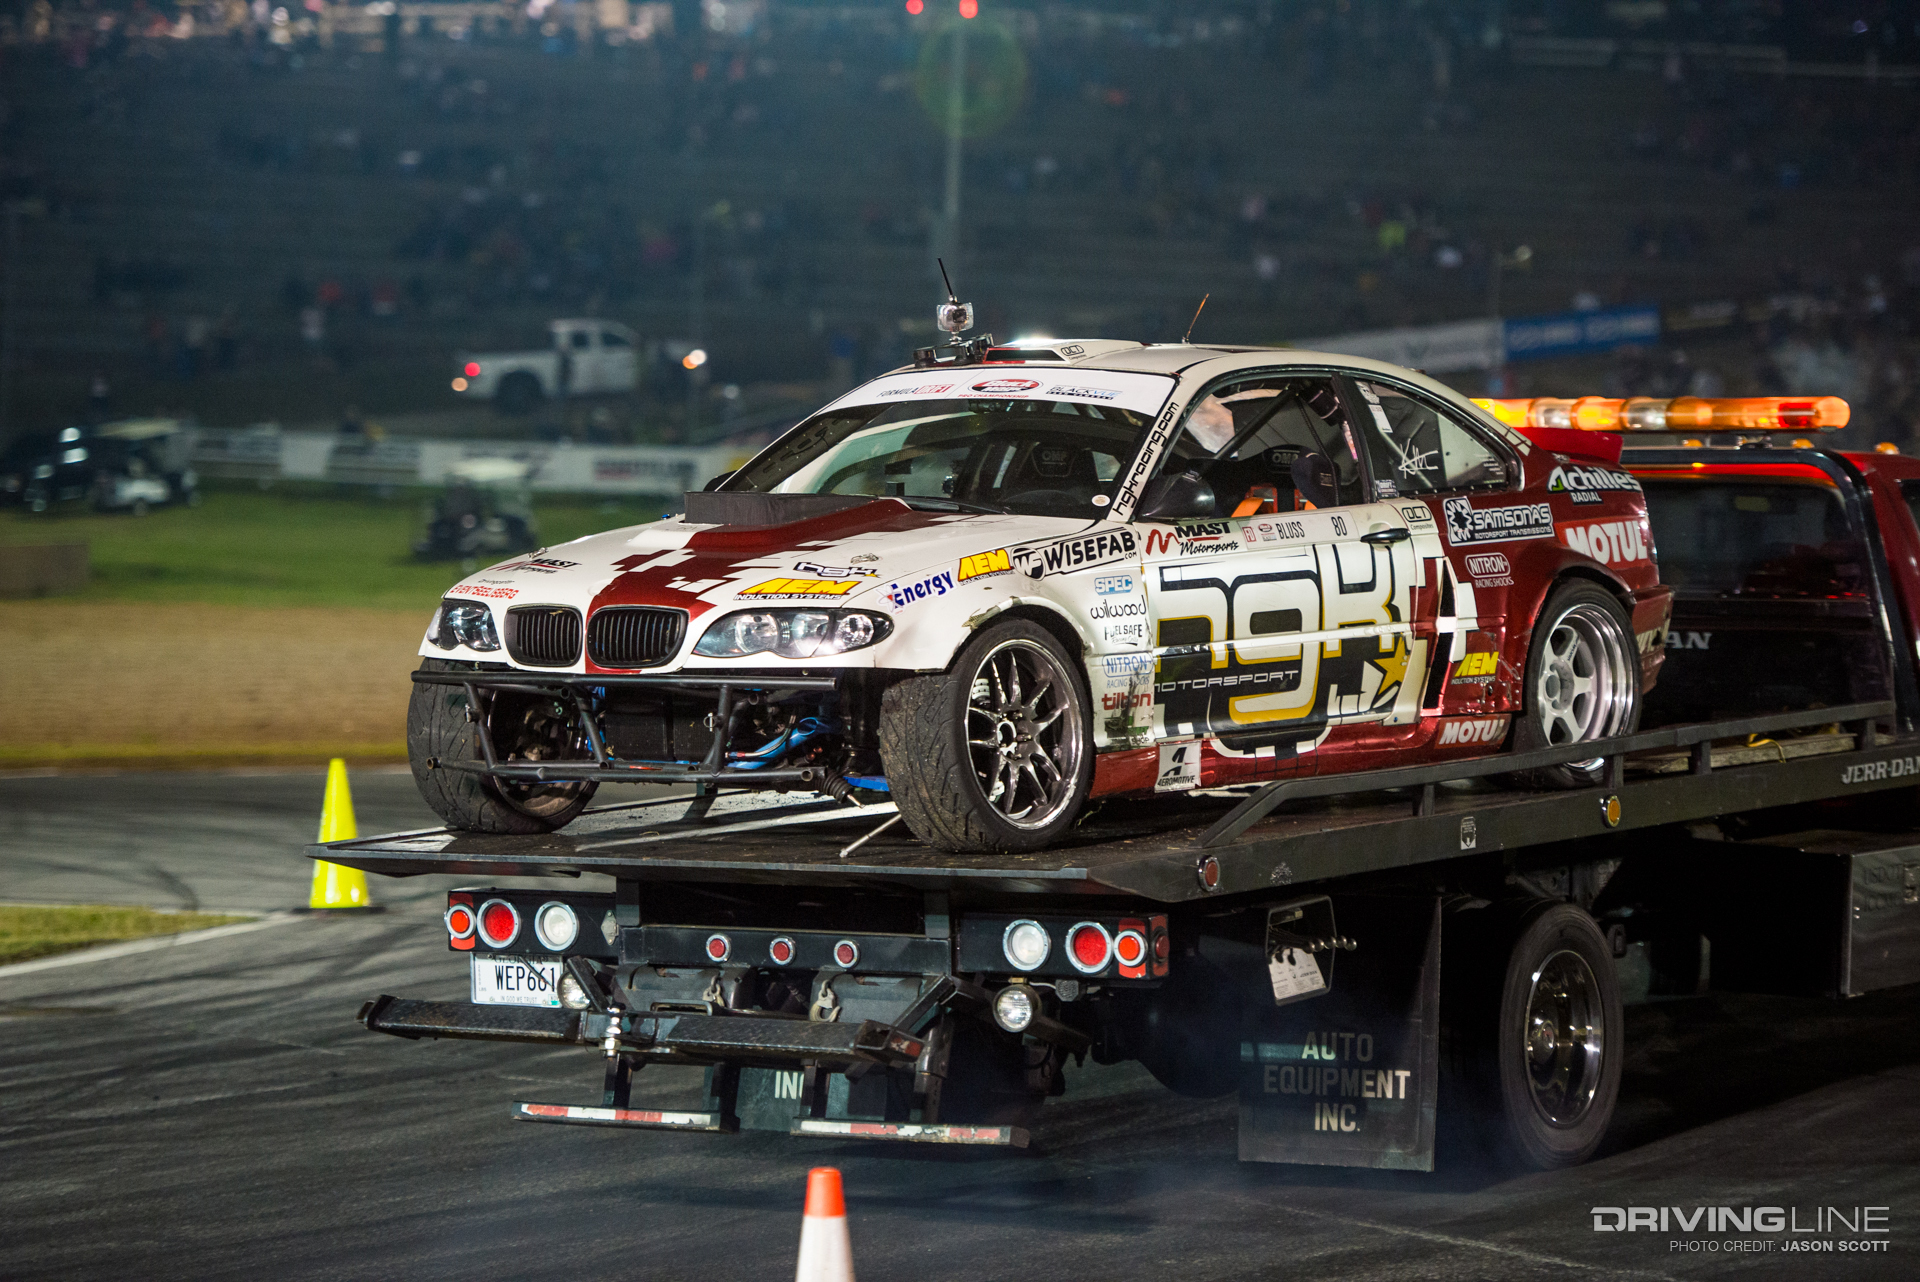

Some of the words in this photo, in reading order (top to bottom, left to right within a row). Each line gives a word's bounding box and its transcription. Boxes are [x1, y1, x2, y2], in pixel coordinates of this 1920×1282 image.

[876, 387, 919, 397] FORMULA
[1112, 402, 1179, 516] hgkracing.com
[1548, 466, 1642, 491] Achilles
[1570, 491, 1603, 502] RADIAL
[1174, 521, 1232, 539] MAST
[1275, 521, 1305, 540] BLUSS
[1331, 516, 1348, 537] 80
[1473, 506, 1551, 530] SAMSONAS
[1043, 531, 1137, 571] WISEFAB
[1180, 541, 1240, 556] Motorsports
[1565, 521, 1649, 565] MOTUL
[957, 548, 1011, 582] AEM
[738, 578, 862, 595] AEM
[892, 571, 955, 610] Energy
[1095, 575, 1132, 593] SPEC
[1475, 579, 1494, 588] RACING
[1494, 576, 1514, 587] SHOCKS
[1090, 594, 1147, 619] wilwood
[1123, 624, 1143, 638] SAFE
[1106, 655, 1149, 674] NITRON
[1454, 651, 1499, 677] AEM
[1106, 679, 1128, 689] RACING
[1157, 775, 1195, 787] AEROMOTIVE
[495, 965, 555, 992] WEP661
[1302, 1031, 1374, 1063] AUTO
[1263, 1065, 1411, 1099] EQUIPMENT
[1314, 1102, 1361, 1132] INC.
